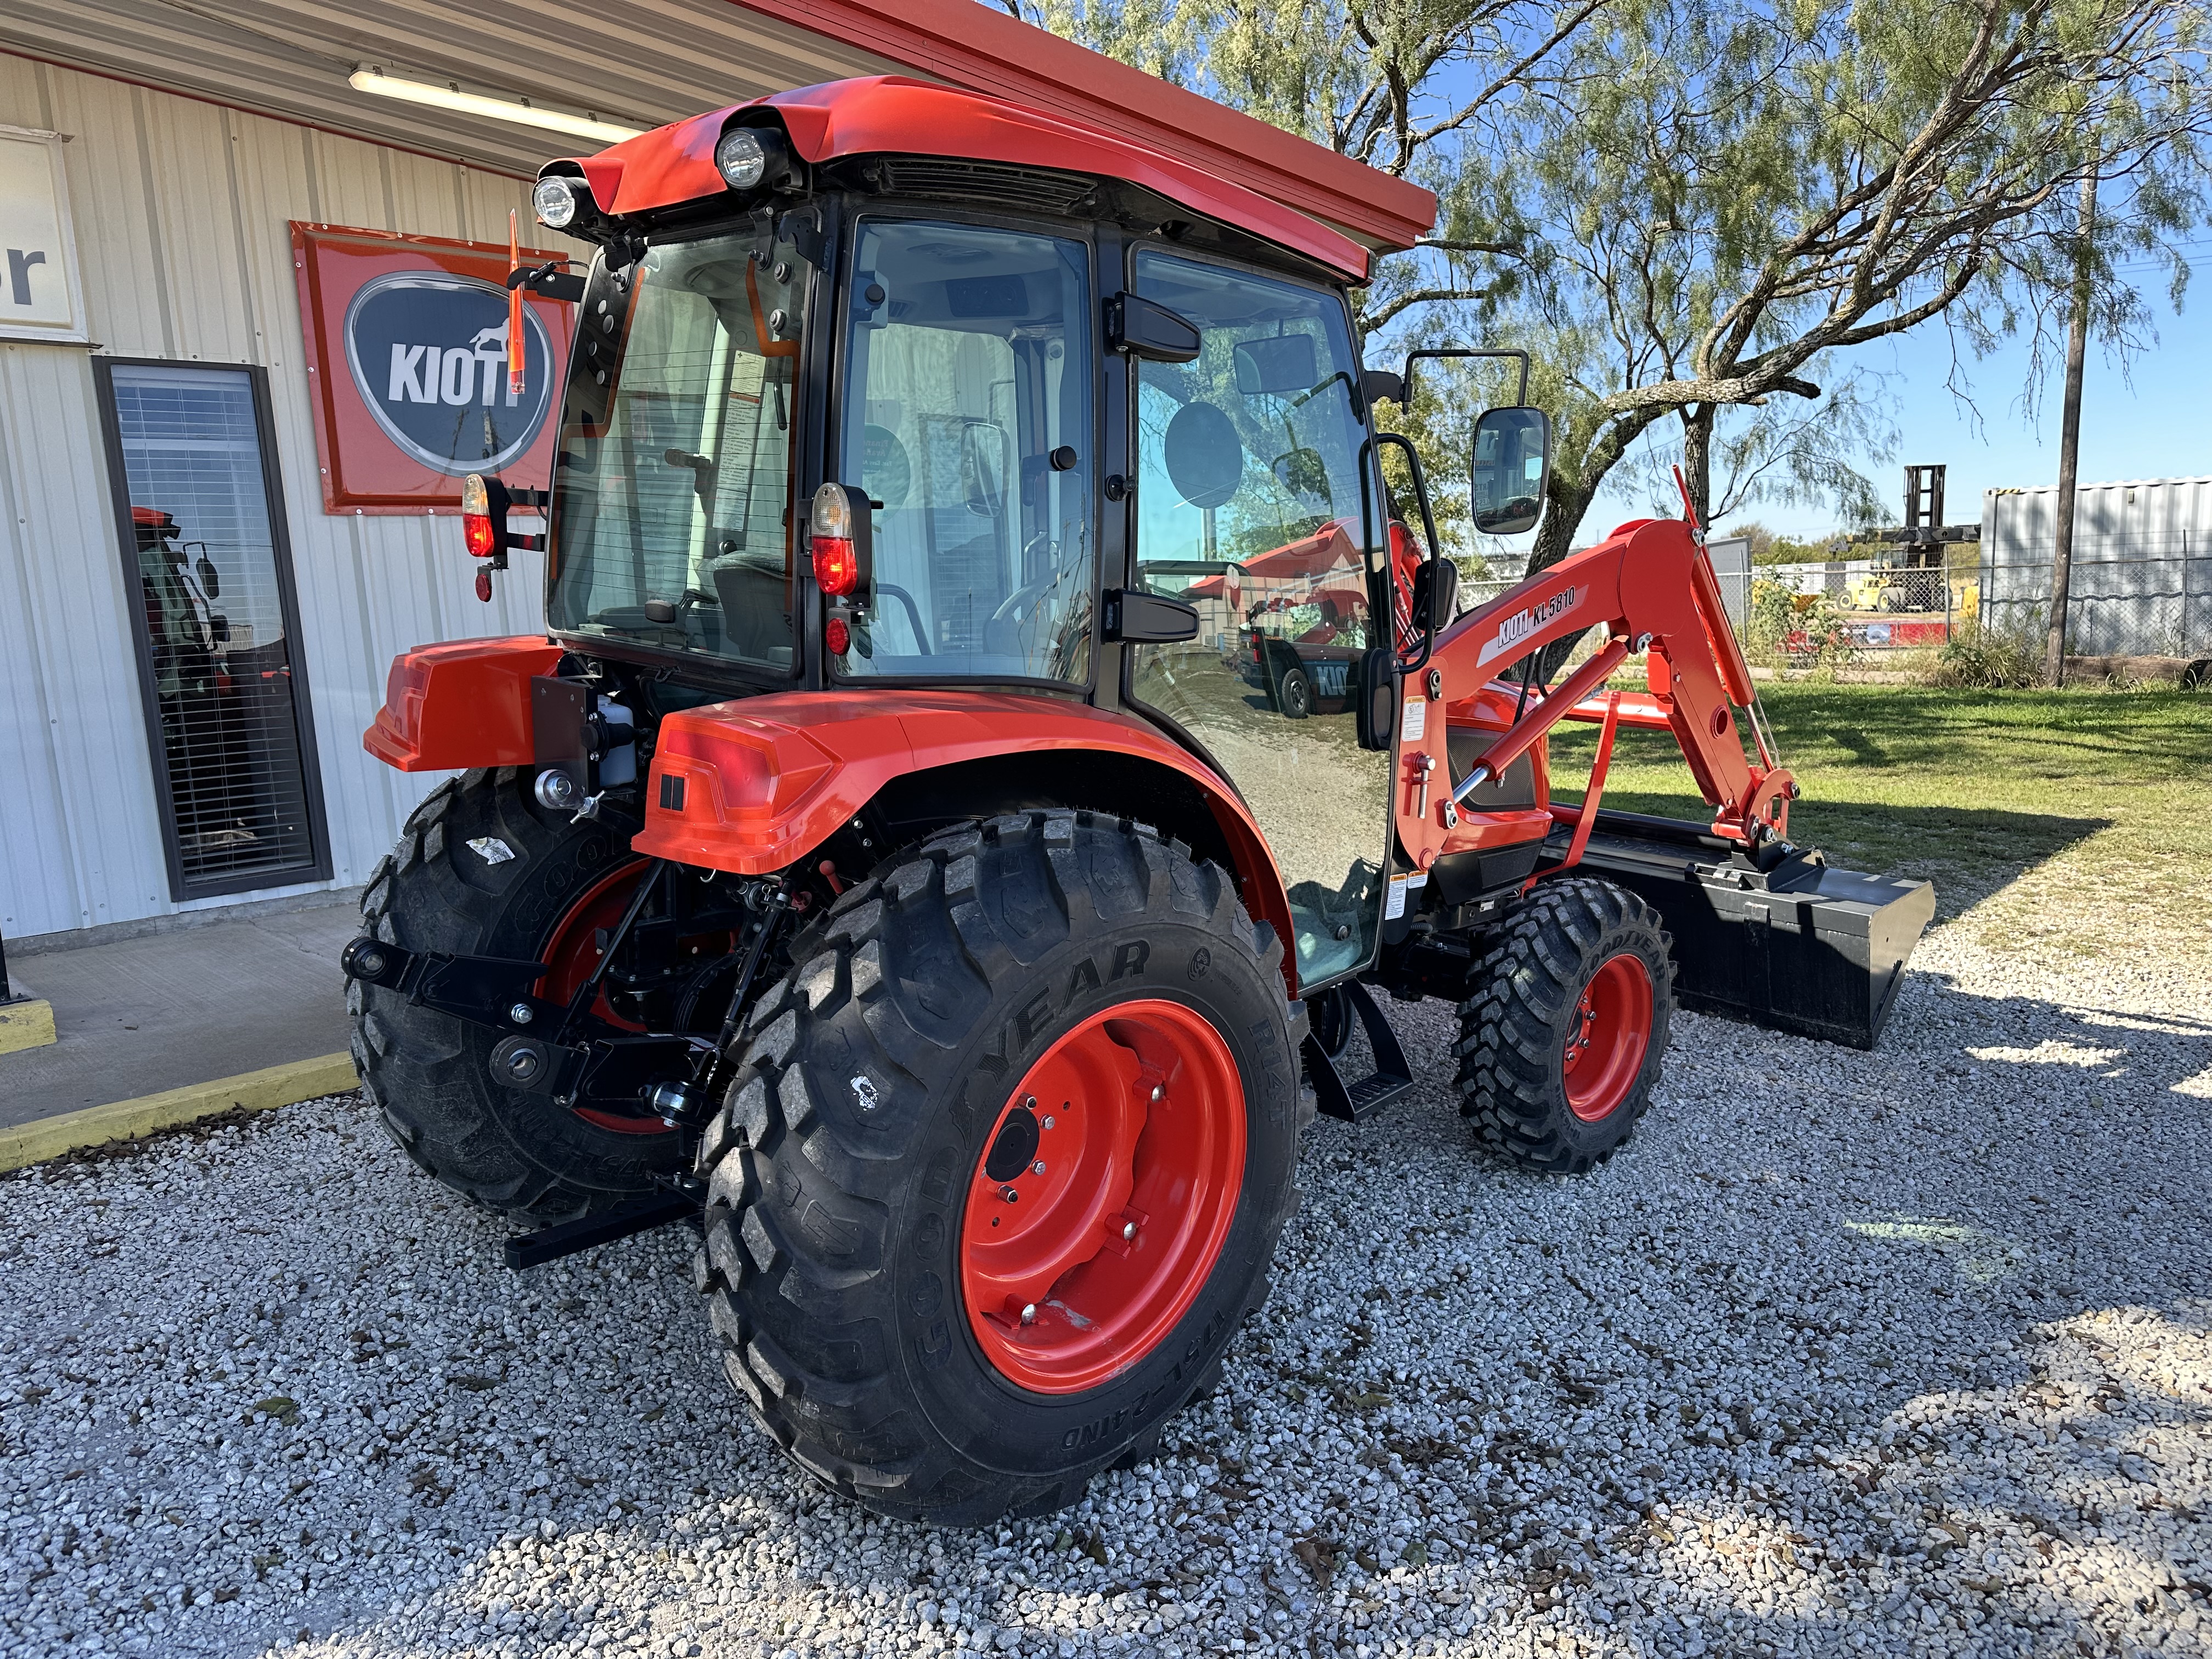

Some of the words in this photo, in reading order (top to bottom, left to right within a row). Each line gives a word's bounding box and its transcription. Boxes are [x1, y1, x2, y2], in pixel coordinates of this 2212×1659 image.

[0, 249, 46, 306] r
[1498, 607, 1529, 648] KIOTI
[1317, 666, 1349, 696] KIO
[1578, 929, 1666, 987] GOODYEAR
